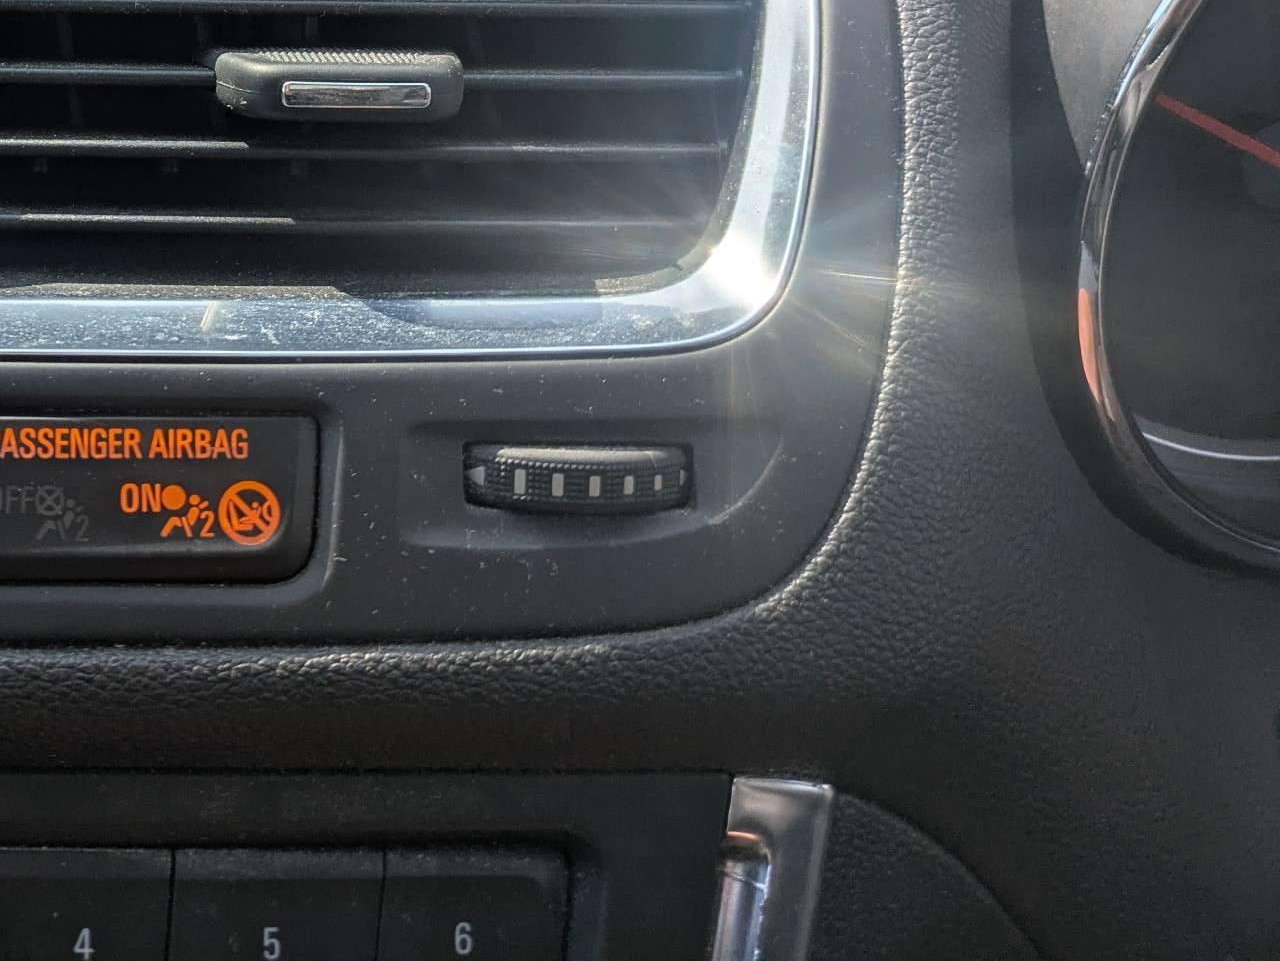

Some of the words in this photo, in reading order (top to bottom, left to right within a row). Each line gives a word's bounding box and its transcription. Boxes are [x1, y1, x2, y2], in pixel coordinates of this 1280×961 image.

[148, 428, 249, 460] AIRBAG
[119, 482, 161, 514] ON
[73, 928, 94, 960] 4
[262, 927, 281, 959] 5
[454, 922, 473, 955] 6
